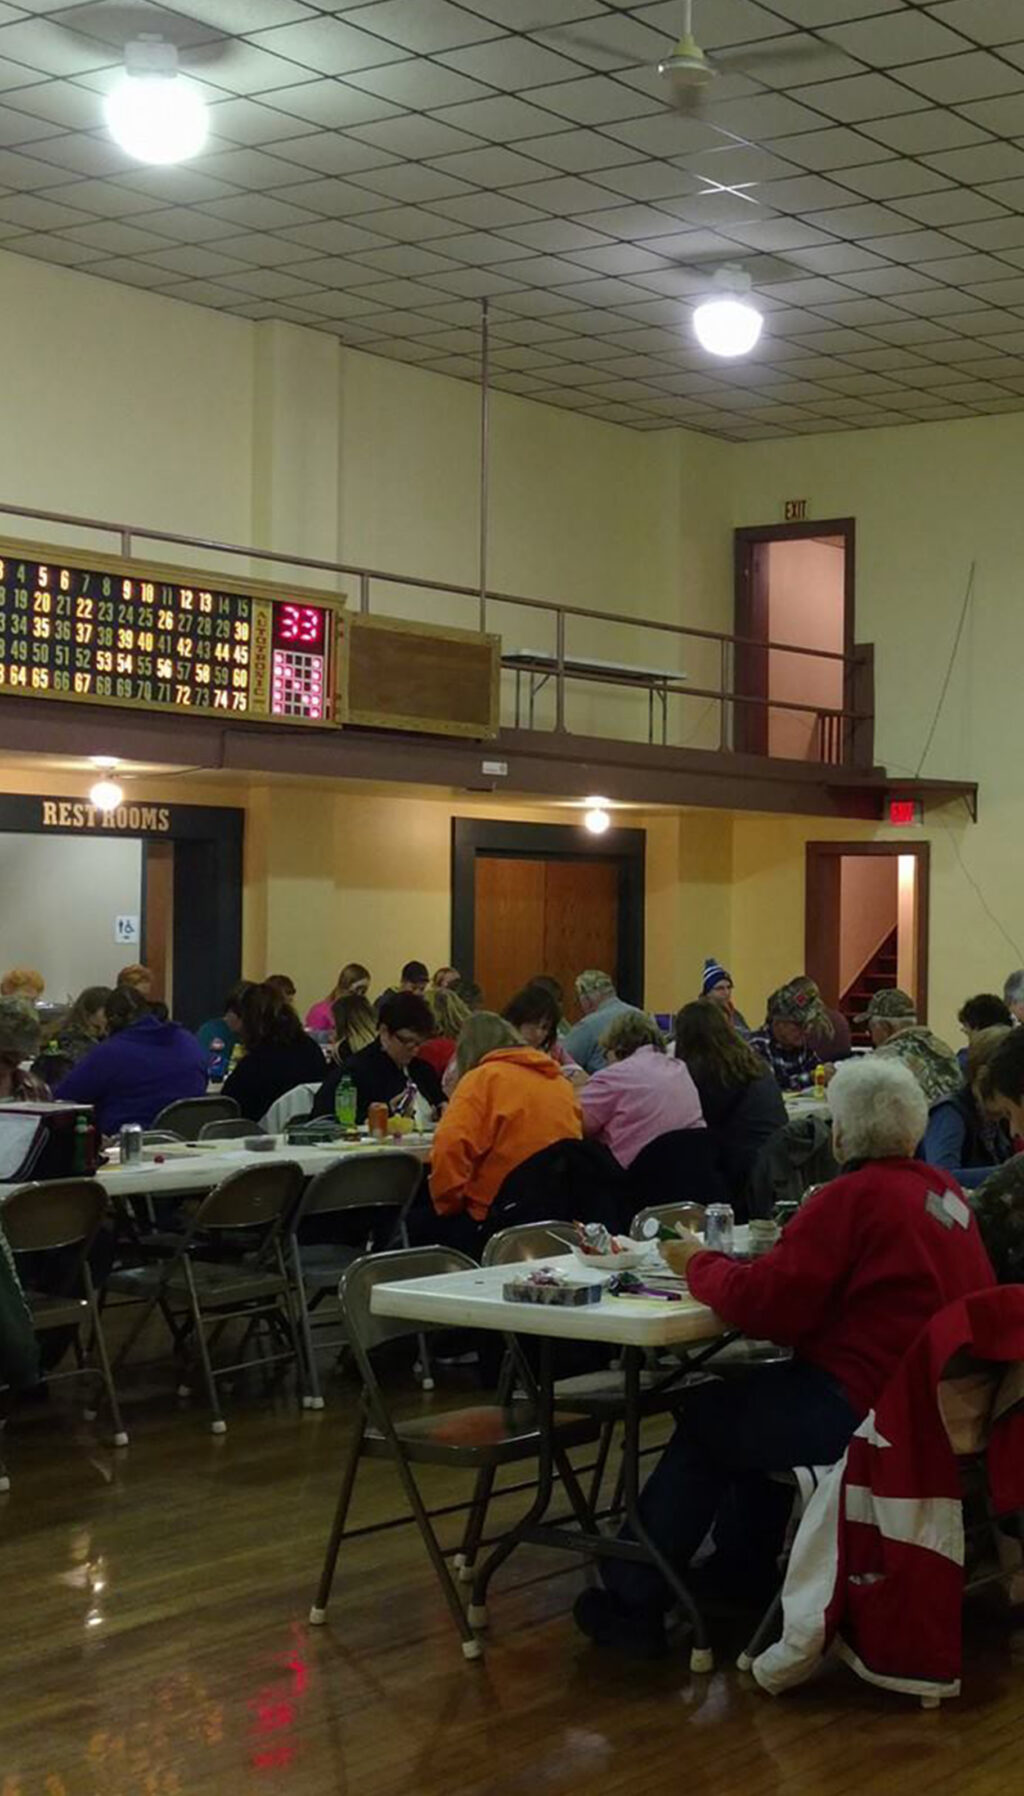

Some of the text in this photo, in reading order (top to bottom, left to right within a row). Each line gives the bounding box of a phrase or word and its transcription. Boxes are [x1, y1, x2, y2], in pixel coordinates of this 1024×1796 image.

[785, 500, 807, 520] EXIT
[17, 564, 25, 583] 4
[38, 566, 48, 587] 5
[60, 570, 70, 590] 6
[82, 574, 90, 593] 7
[102, 577, 111, 596] 8
[122, 580, 132, 600] 9
[141, 584, 154, 604] 10
[162, 586, 172, 605] 11
[180, 590, 193, 610] 12
[199, 592, 212, 612] 13
[219, 596, 230, 614] 14
[238, 600, 248, 618] 15
[14, 588, 28, 609] 19
[33, 592, 50, 613] 20
[56, 595, 70, 616] 21
[76, 598, 92, 618] 22
[99, 602, 114, 622] 23
[118, 604, 134, 624] 24
[138, 608, 153, 626] 25
[158, 610, 173, 630] 26
[178, 614, 192, 632] 27
[197, 616, 212, 636] 28
[216, 620, 230, 638] 29
[234, 621, 249, 641] 30
[281, 606, 318, 641] 33
[11, 614, 28, 635] 34
[33, 617, 50, 638] 35
[55, 620, 71, 640] 36
[76, 623, 92, 644] 37
[97, 626, 113, 646] 38
[118, 628, 134, 649] 39
[138, 632, 154, 652] 40
[158, 635, 172, 654] 41
[176, 638, 192, 658] 42
[196, 641, 211, 660] 43
[214, 642, 230, 662] 44
[233, 645, 248, 664] 45
[11, 640, 28, 661] 49
[32, 643, 49, 663] 50
[55, 645, 70, 666] 51
[75, 648, 92, 668] 52
[96, 651, 112, 671] 53
[116, 654, 133, 674] 54
[137, 656, 152, 676] 55
[156, 658, 172, 678] 56
[176, 662, 192, 680] 57
[195, 664, 210, 684] 58
[214, 667, 228, 686] 59
[232, 668, 248, 688] 60
[10, 666, 26, 686] 64
[32, 668, 49, 688] 65
[54, 670, 70, 690] 66
[74, 672, 92, 693] 67
[96, 676, 112, 696] 68
[116, 678, 132, 698] 69
[136, 681, 152, 700] 70
[157, 683, 171, 702] 71
[176, 685, 191, 704] 72
[195, 688, 210, 706] 73
[214, 690, 228, 708] 74
[232, 692, 247, 711] 75
[43, 801, 170, 831] REST ROOMS
